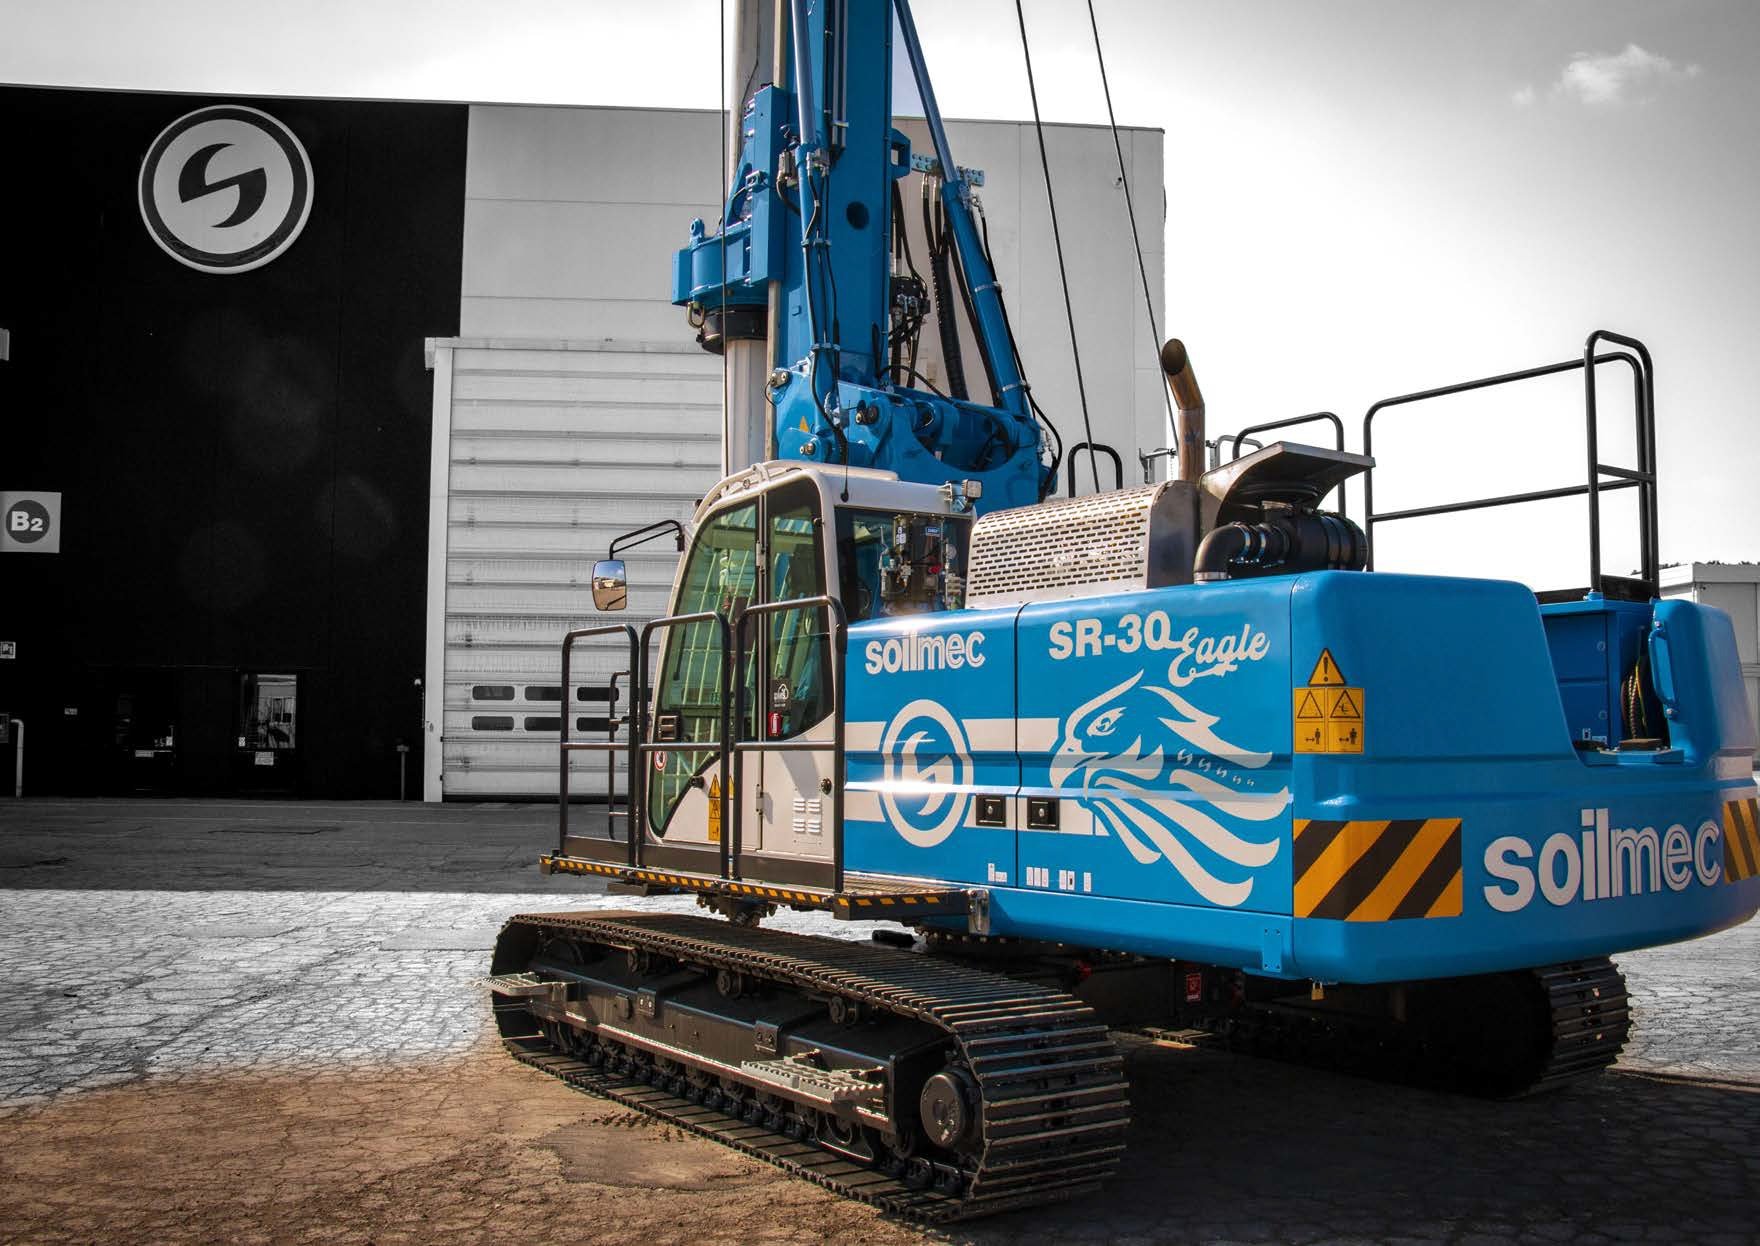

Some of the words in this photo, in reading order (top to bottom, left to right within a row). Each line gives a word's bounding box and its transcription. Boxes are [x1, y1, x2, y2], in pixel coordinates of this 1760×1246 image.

[11, 510, 43, 532] B2
[865, 631, 986, 675] soilmec
[1048, 610, 1172, 660] SR-30
[1167, 624, 1270, 688] Eagle
[1483, 807, 1721, 913] soilmec
